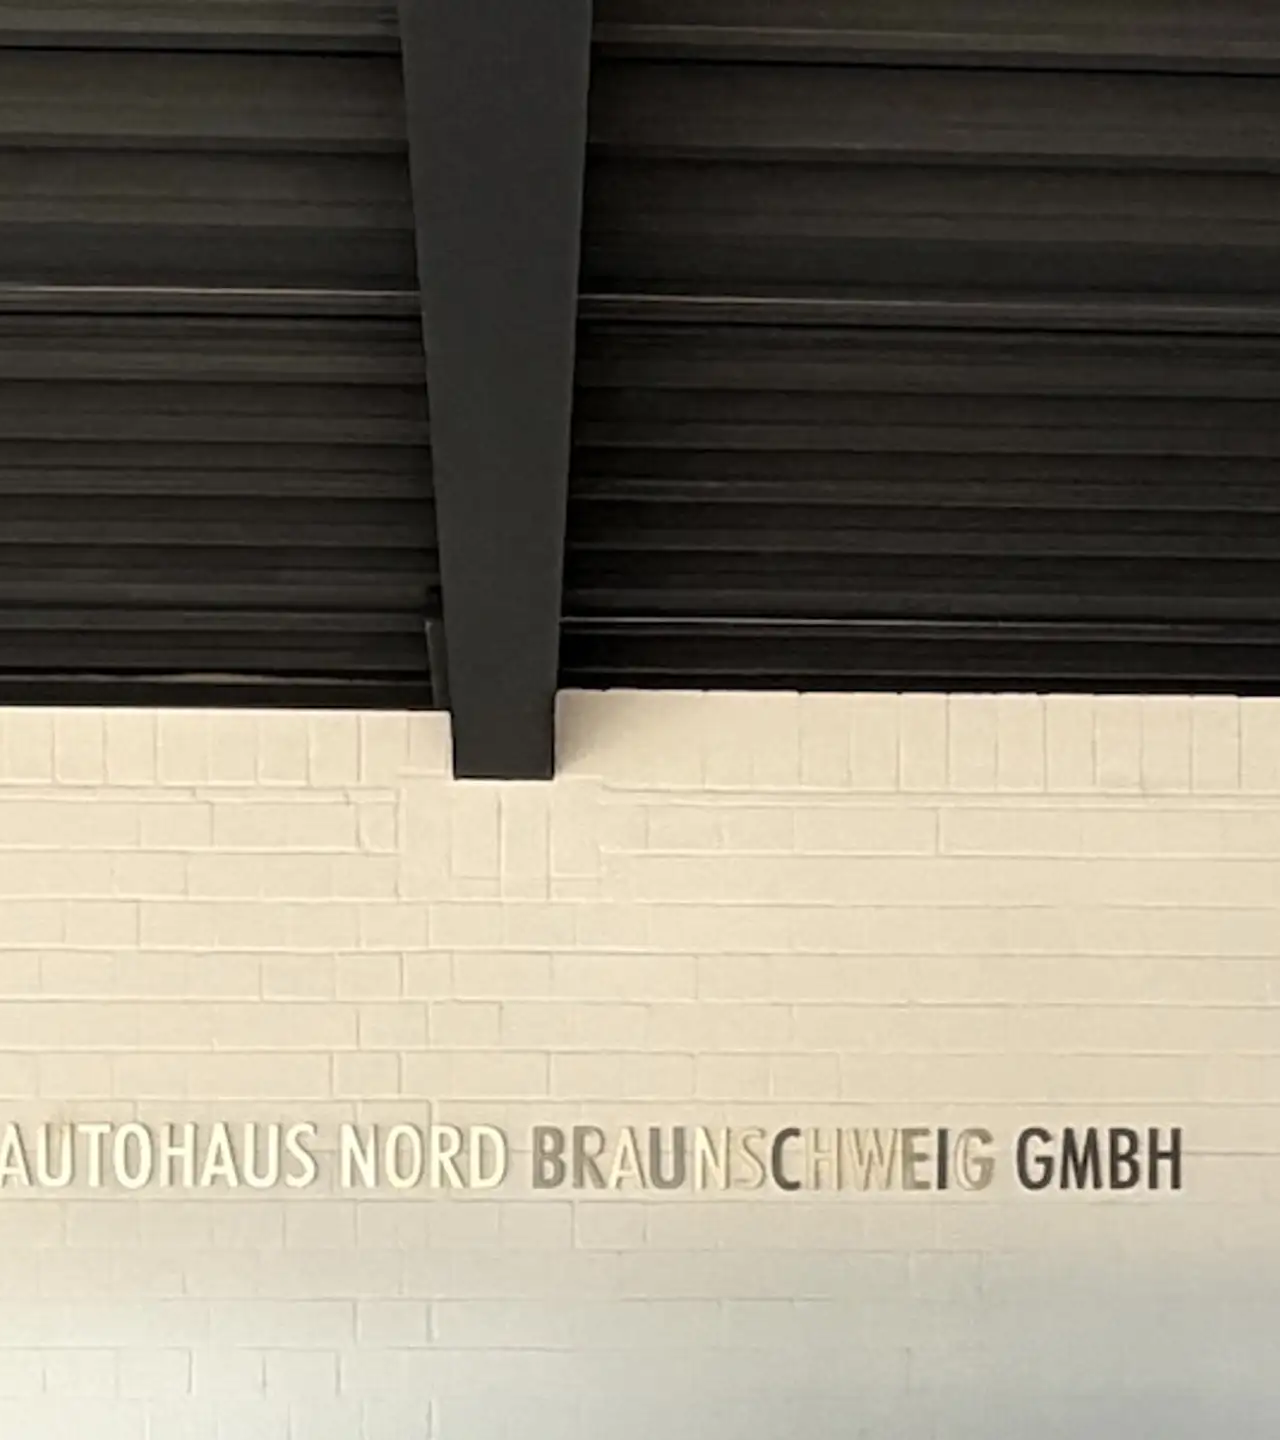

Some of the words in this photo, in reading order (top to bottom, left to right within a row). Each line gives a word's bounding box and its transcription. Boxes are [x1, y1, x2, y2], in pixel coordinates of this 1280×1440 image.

[340, 1123, 509, 1189] NORD
[531, 1126, 996, 1190] BRAUNSCHWEIG
[1016, 1126, 1183, 1191] GMBH
